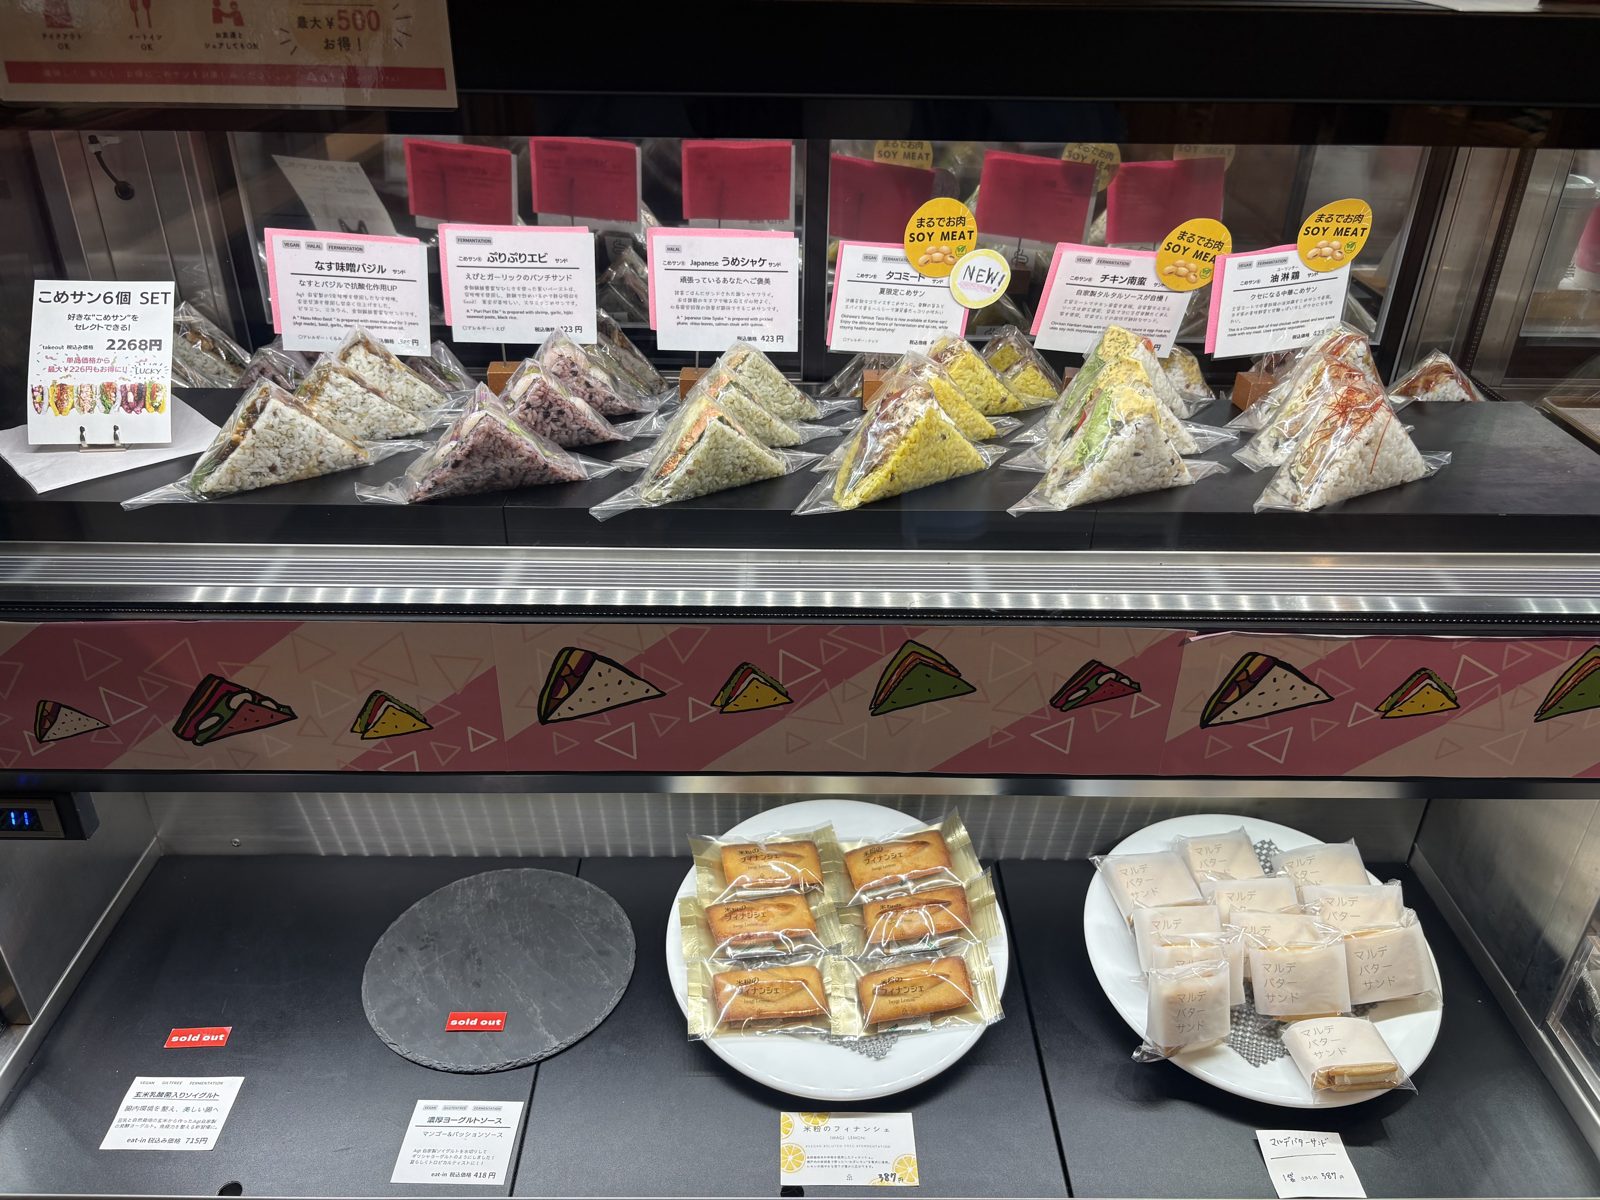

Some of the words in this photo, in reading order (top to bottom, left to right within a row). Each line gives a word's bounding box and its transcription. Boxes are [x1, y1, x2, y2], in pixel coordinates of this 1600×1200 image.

[916, 216, 966, 228] まるでお肉
[1315, 214, 1364, 223] まるでお肉
[909, 232, 934, 242] SOY
[940, 230, 974, 241] MEAT
[1303, 227, 1329, 236] SOY
[1333, 227, 1367, 237] MEAT
[1177, 230, 1225, 251] まるでお肉
[487, 252, 548, 263] ぷりぷりエビ
[1164, 241, 1190, 255] SOY
[1193, 249, 1216, 264] MEA
[314, 260, 386, 274] なす味噌バジル
[721, 257, 767, 267] うめシャケ
[680, 276, 771, 285] 頑張っているあなたへご褒美
[1100, 274, 1147, 286] チキン南蛮
[1270, 270, 1300, 283] 油淋鶏
[299, 279, 397, 291] なすとバジルで抗酸化作用UP
[38, 291, 131, 305] こめサン6個
[140, 292, 171, 304] SET
[879, 288, 926, 297] 夏限定こめサン
[1250, 286, 1317, 300] クセになる中華こめサン
[106, 339, 162, 351] 2268円
[1194, 844, 1222, 855] マルデ
[1120, 864, 1148, 876] マルデ
[1226, 890, 1256, 901] マルデ
[1325, 896, 1359, 906] マルデ
[1327, 911, 1360, 921] バター
[1152, 919, 1182, 930] マルデ
[1354, 946, 1388, 960] マルデ
[1263, 962, 1296, 973] マルデ
[1359, 963, 1392, 976] バター
[1264, 978, 1296, 988] バター
[1364, 976, 1396, 991] サンド
[1177, 991, 1207, 1003] マルデ
[1267, 993, 1300, 1003] サンド
[1176, 1009, 1206, 1017] バター
[1176, 1020, 1205, 1033] サンド
[1301, 1025, 1334, 1038] マルデ
[171, 1034, 201, 1042] sold
[1308, 1038, 1342, 1048] バター
[1313, 1047, 1348, 1060] サンド
[426, 1116, 502, 1124] 濃厚ヨーグルトソース
[878, 1172, 896, 1182] 387
